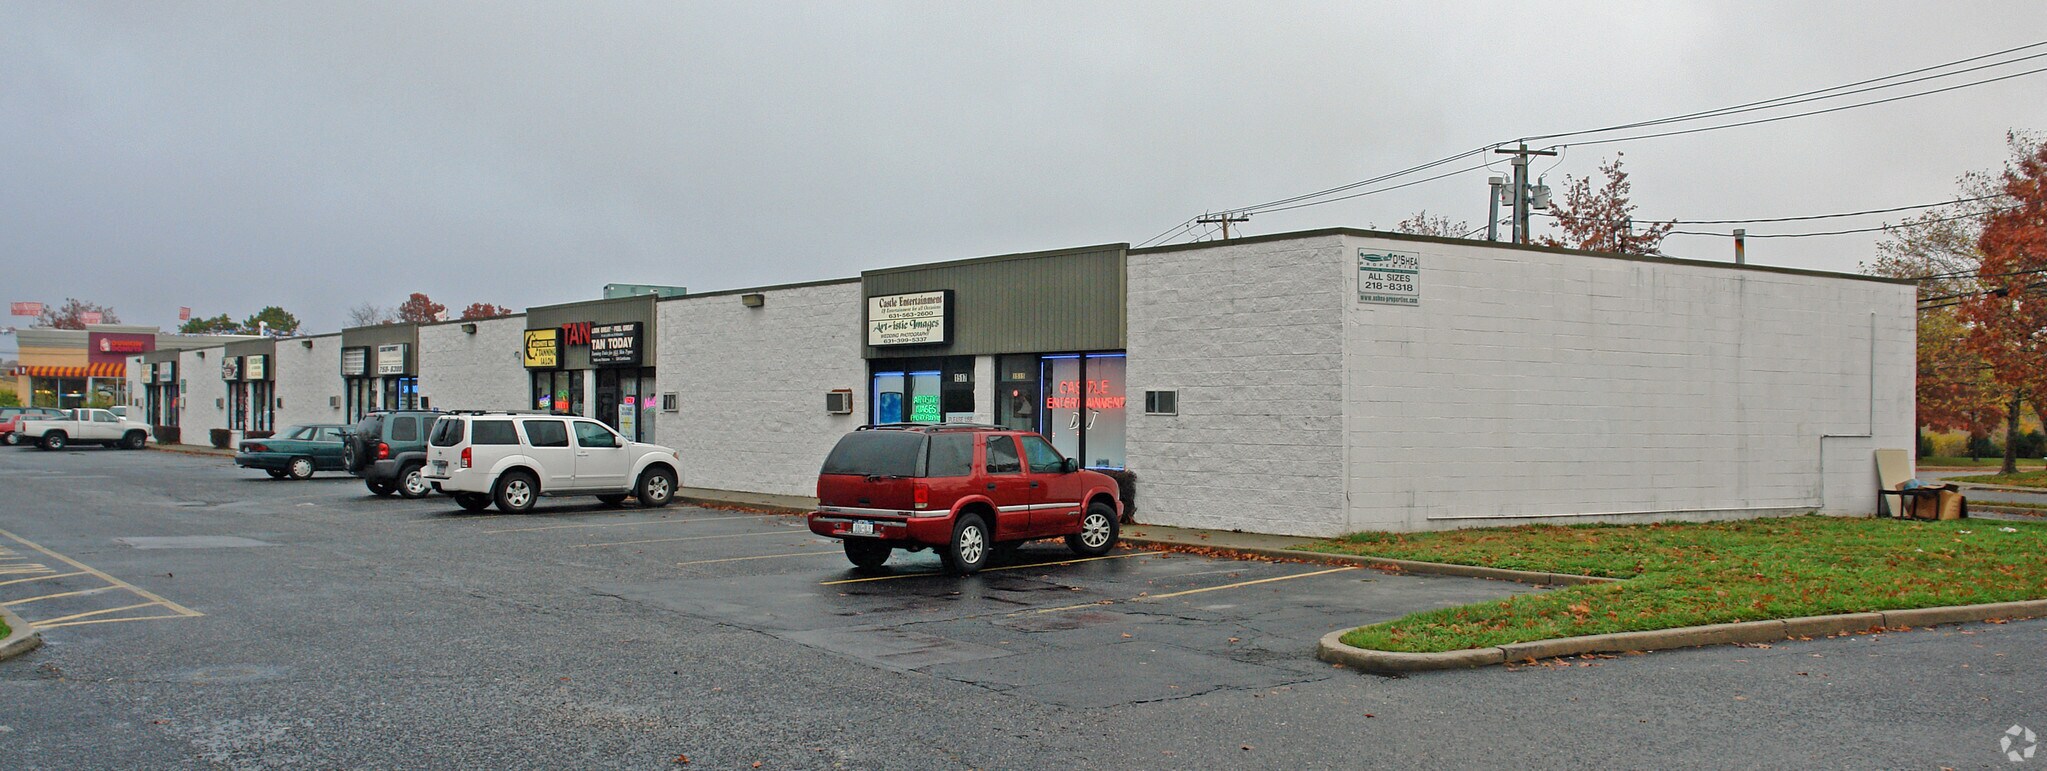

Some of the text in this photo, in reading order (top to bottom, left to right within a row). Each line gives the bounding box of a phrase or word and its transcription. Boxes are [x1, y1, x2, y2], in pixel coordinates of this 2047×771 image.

[1393, 254, 1418, 266] O'SHEA
[1368, 272, 1411, 283] ALL SIZES
[1365, 281, 1414, 292] 218-8318
[879, 295, 942, 308] Castle Entertainment
[622, 324, 634, 332] GREAT
[873, 320, 939, 333] Art-istic Images
[562, 322, 591, 345] TAN
[591, 336, 634, 350] TAN TODAY
[540, 357, 554, 365] SALON
[1060, 381, 1109, 394] CASTLE
